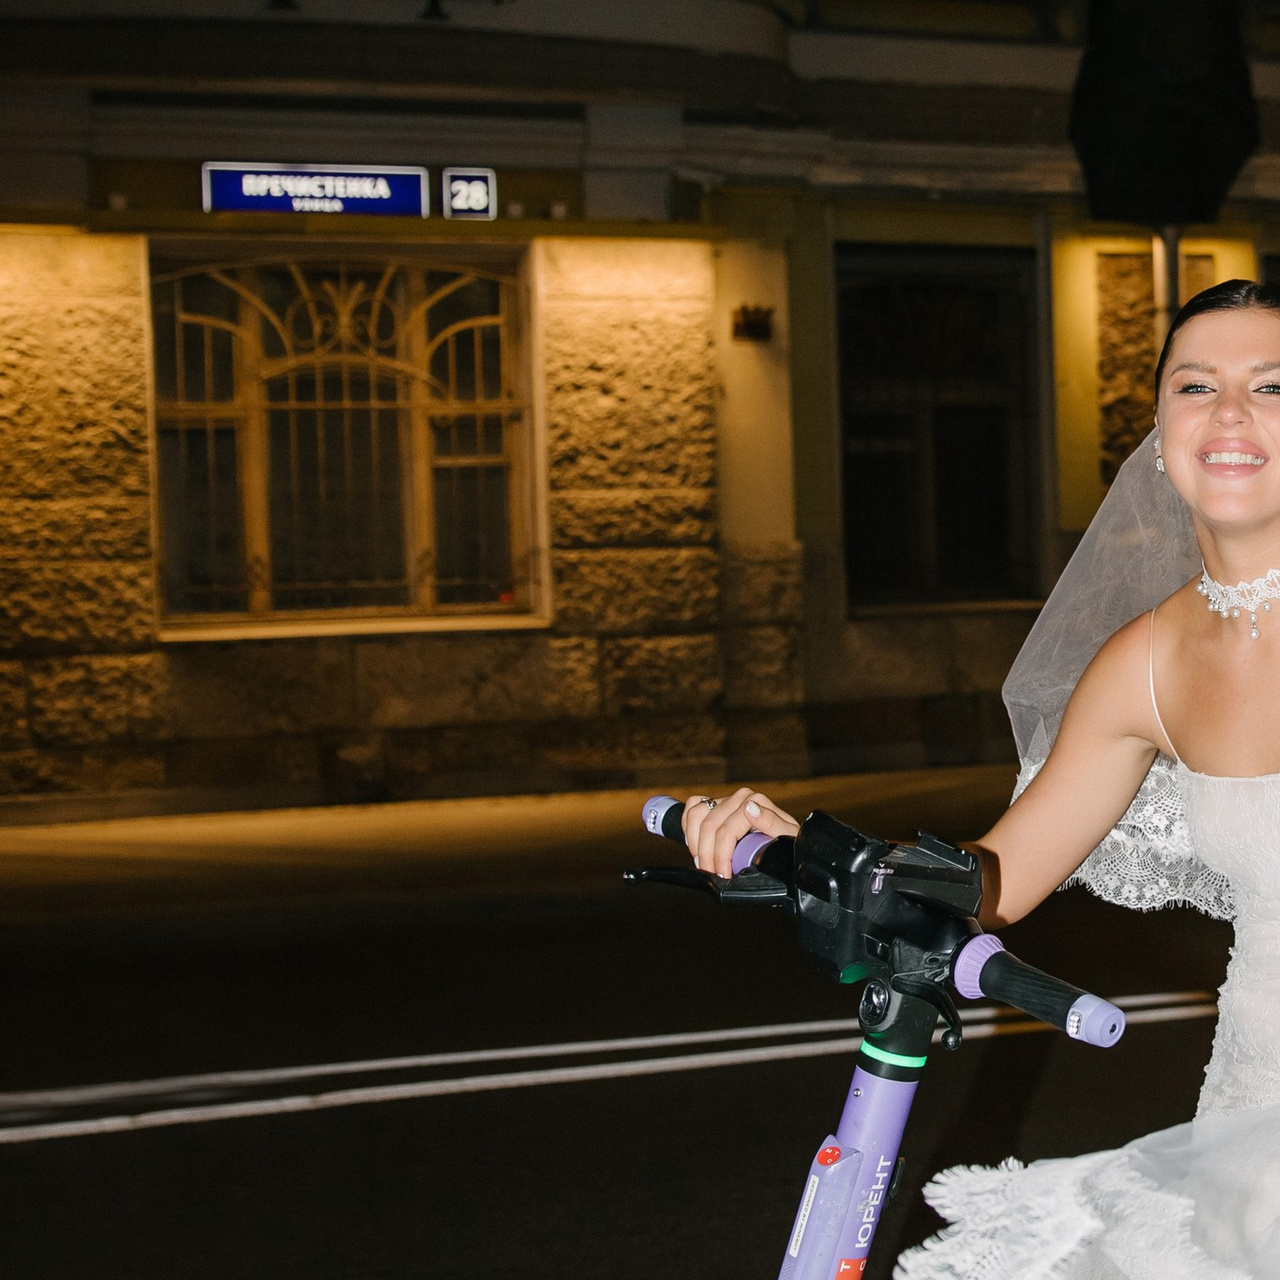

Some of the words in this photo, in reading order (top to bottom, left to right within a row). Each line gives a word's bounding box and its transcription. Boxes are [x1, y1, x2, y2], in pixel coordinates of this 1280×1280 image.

[241, 174, 392, 199] ПРЕЧИСТЕНКА
[450, 179, 489, 210] 28
[855, 1155, 892, 1248] ЮРЕНТ
